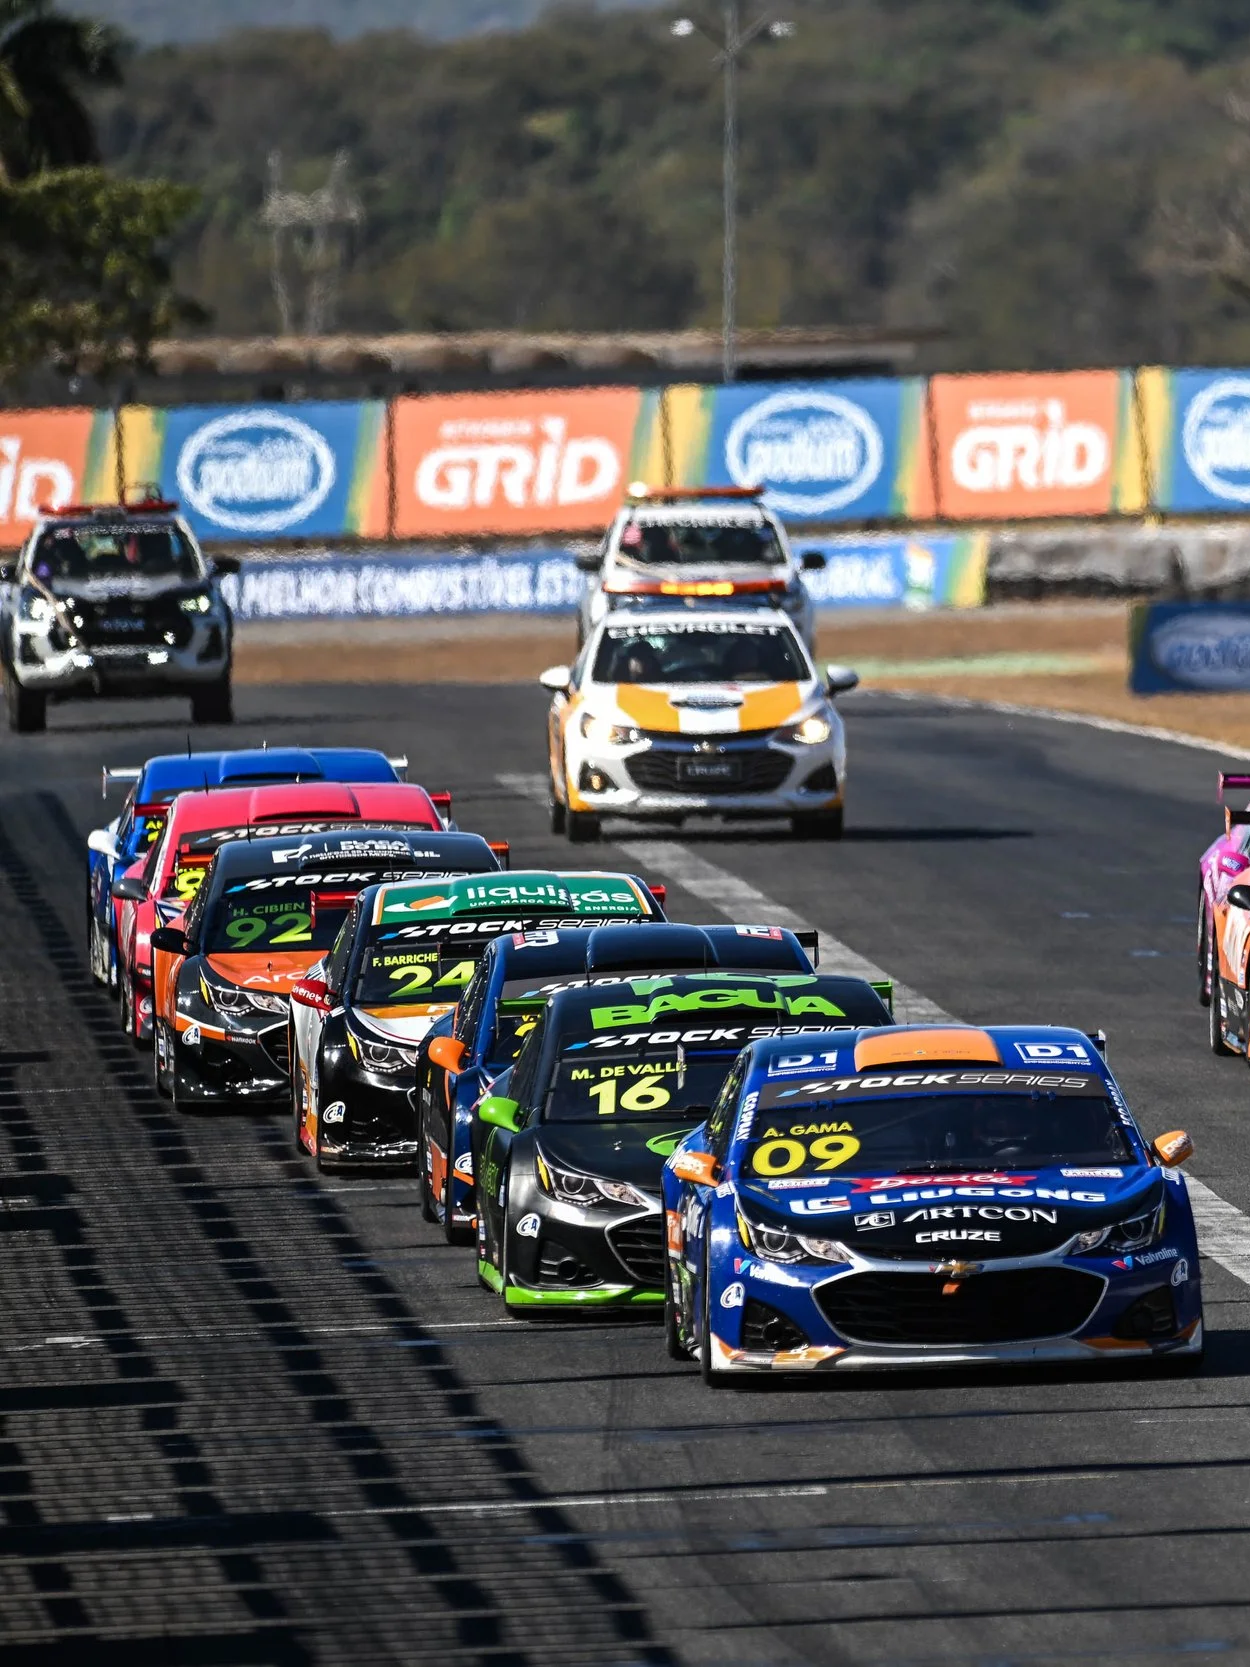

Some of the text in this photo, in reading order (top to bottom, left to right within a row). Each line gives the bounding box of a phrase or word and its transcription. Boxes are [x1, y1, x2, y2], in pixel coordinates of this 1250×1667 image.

[951, 399, 1109, 494] GRID
[414, 416, 621, 511] GRID
[207, 823, 328, 844] STOCK
[245, 872, 376, 891] STOCK
[466, 884, 636, 906] liquigás
[232, 902, 305, 917] H. CIBIEN
[225, 912, 312, 948] 92
[398, 920, 533, 938] STOCK
[373, 952, 438, 967] F. BARRICHE
[388, 960, 475, 997] 24
[590, 989, 846, 1030] BAGUA
[589, 1028, 746, 1049] STOCK
[777, 1050, 838, 1069] D1
[1024, 1045, 1089, 1058] D1
[571, 1068, 595, 1080] M.
[600, 1065, 625, 1078] DE
[800, 1072, 1089, 1095] STOCK SERIES
[588, 1074, 671, 1115] 16
[763, 1121, 853, 1139] A. GAMA
[752, 1135, 861, 1176] 09
[869, 1187, 1106, 1204] LIUGONG
[902, 1206, 1058, 1224] ARTCON
[915, 1230, 1001, 1244] CRUZE
[1135, 1248, 1179, 1266] Valvoline
